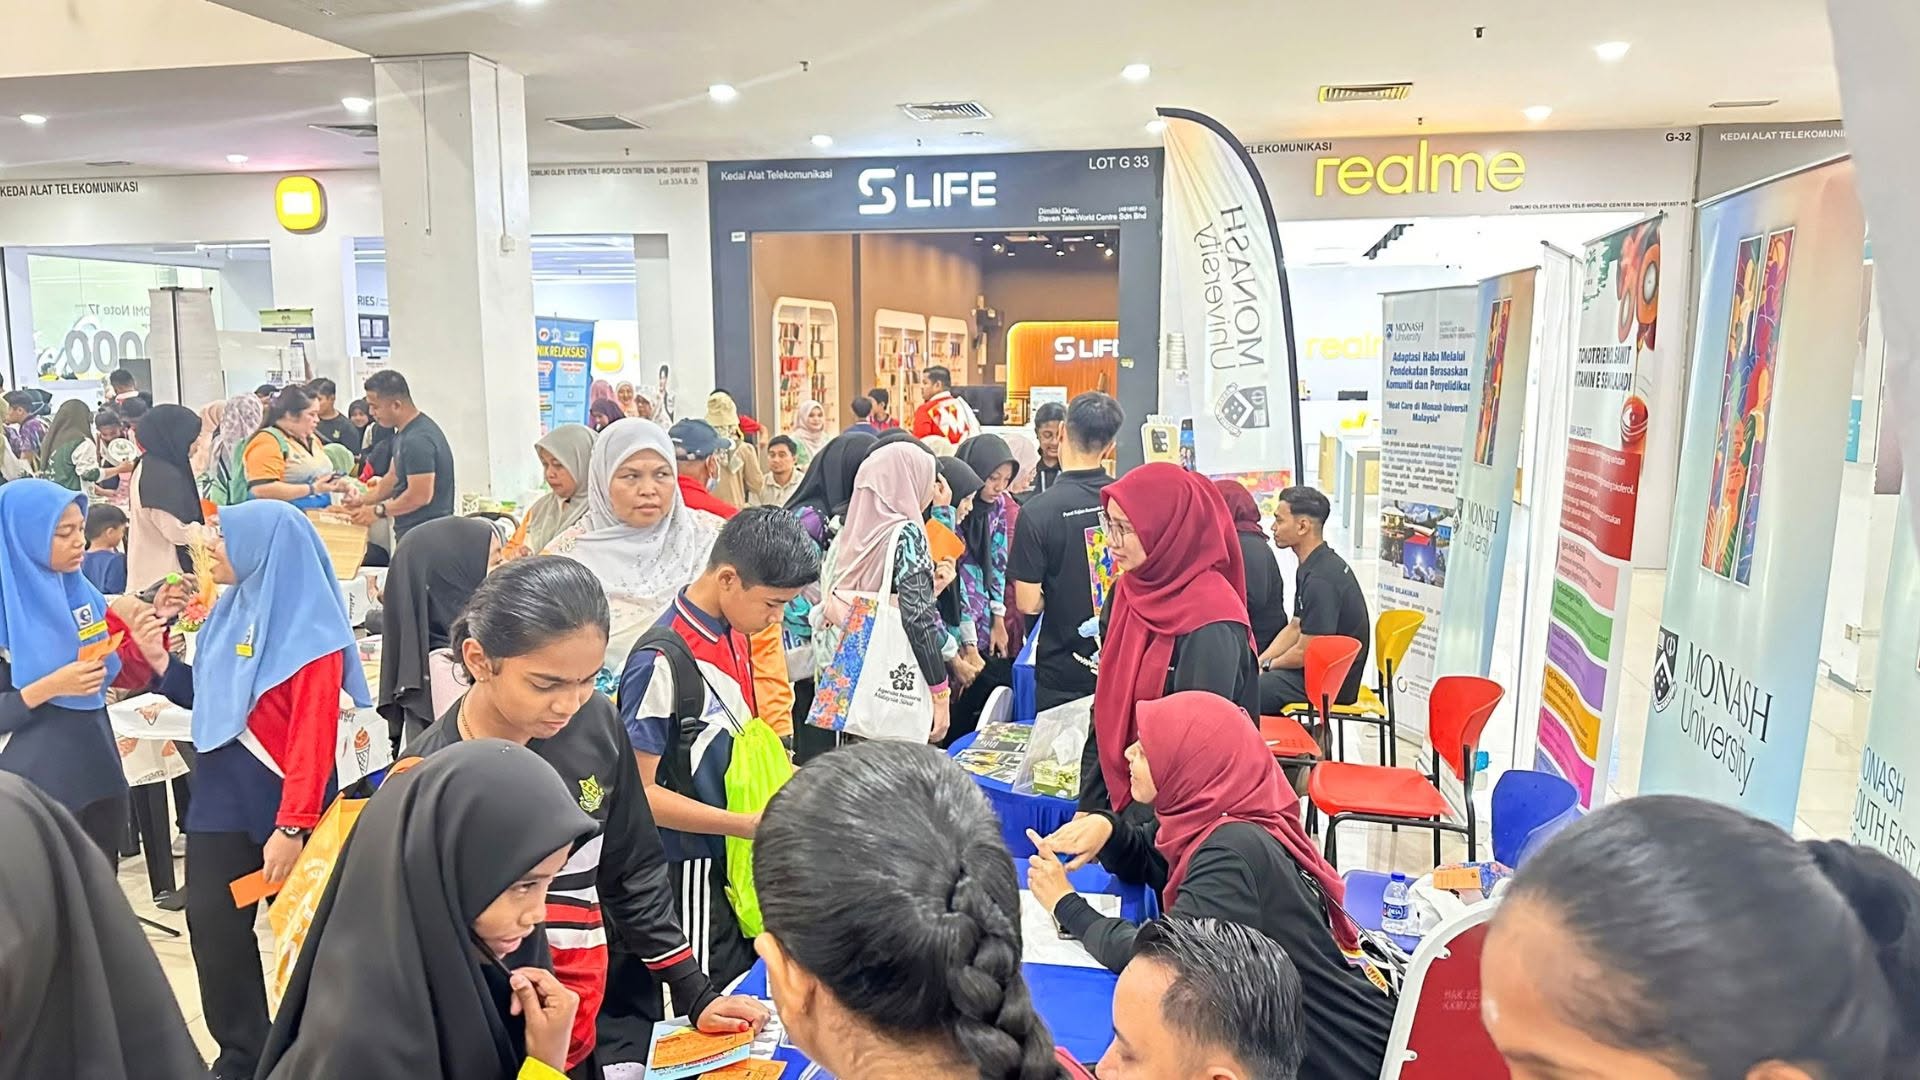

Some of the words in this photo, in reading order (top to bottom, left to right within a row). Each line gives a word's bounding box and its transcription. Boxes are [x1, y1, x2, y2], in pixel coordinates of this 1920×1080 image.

[1665, 132, 1691, 142] G-32
[1720, 133, 1750, 141] KEDAI
[1752, 131, 1777, 140] ALAT
[1089, 157, 1116, 170] LOT
[1119, 156, 1130, 169] G
[1133, 155, 1150, 168] 33
[1315, 140, 1526, 197] realme
[721, 171, 746, 181] Kedai
[747, 170, 765, 180] Alat
[767, 169, 833, 180] Telekomunikasi
[0, 186, 28, 197] KEDAI
[30, 184, 53, 196] ALAT
[55, 181, 138, 195] TELEKOMUNIKASI
[906, 171, 997, 208] LIFE
[1395, 322, 1424, 332] MONASH
[1394, 332, 1422, 342] University
[550, 345, 588, 358] RELAKSASI
[1392, 351, 1421, 363] Adaptasi
[1422, 351, 1440, 362] Haba
[1441, 350, 1466, 362] Melalui
[1389, 365, 1428, 376] Pendekatan
[1430, 365, 1468, 377] Berasaskan
[1386, 380, 1413, 390] Komuniti
[1414, 380, 1428, 390] dan
[1401, 401, 1413, 410] Care
[1414, 402, 1420, 410] di
[1421, 402, 1442, 411] Monash
[1443, 403, 1468, 413] Universit
[1467, 500, 1500, 534] MONASH
[1684, 641, 1773, 744] MONASH
[1680, 687, 1754, 797] University
[1861, 745, 1906, 811] ONASH
[1853, 787, 1887, 847] OUTH
